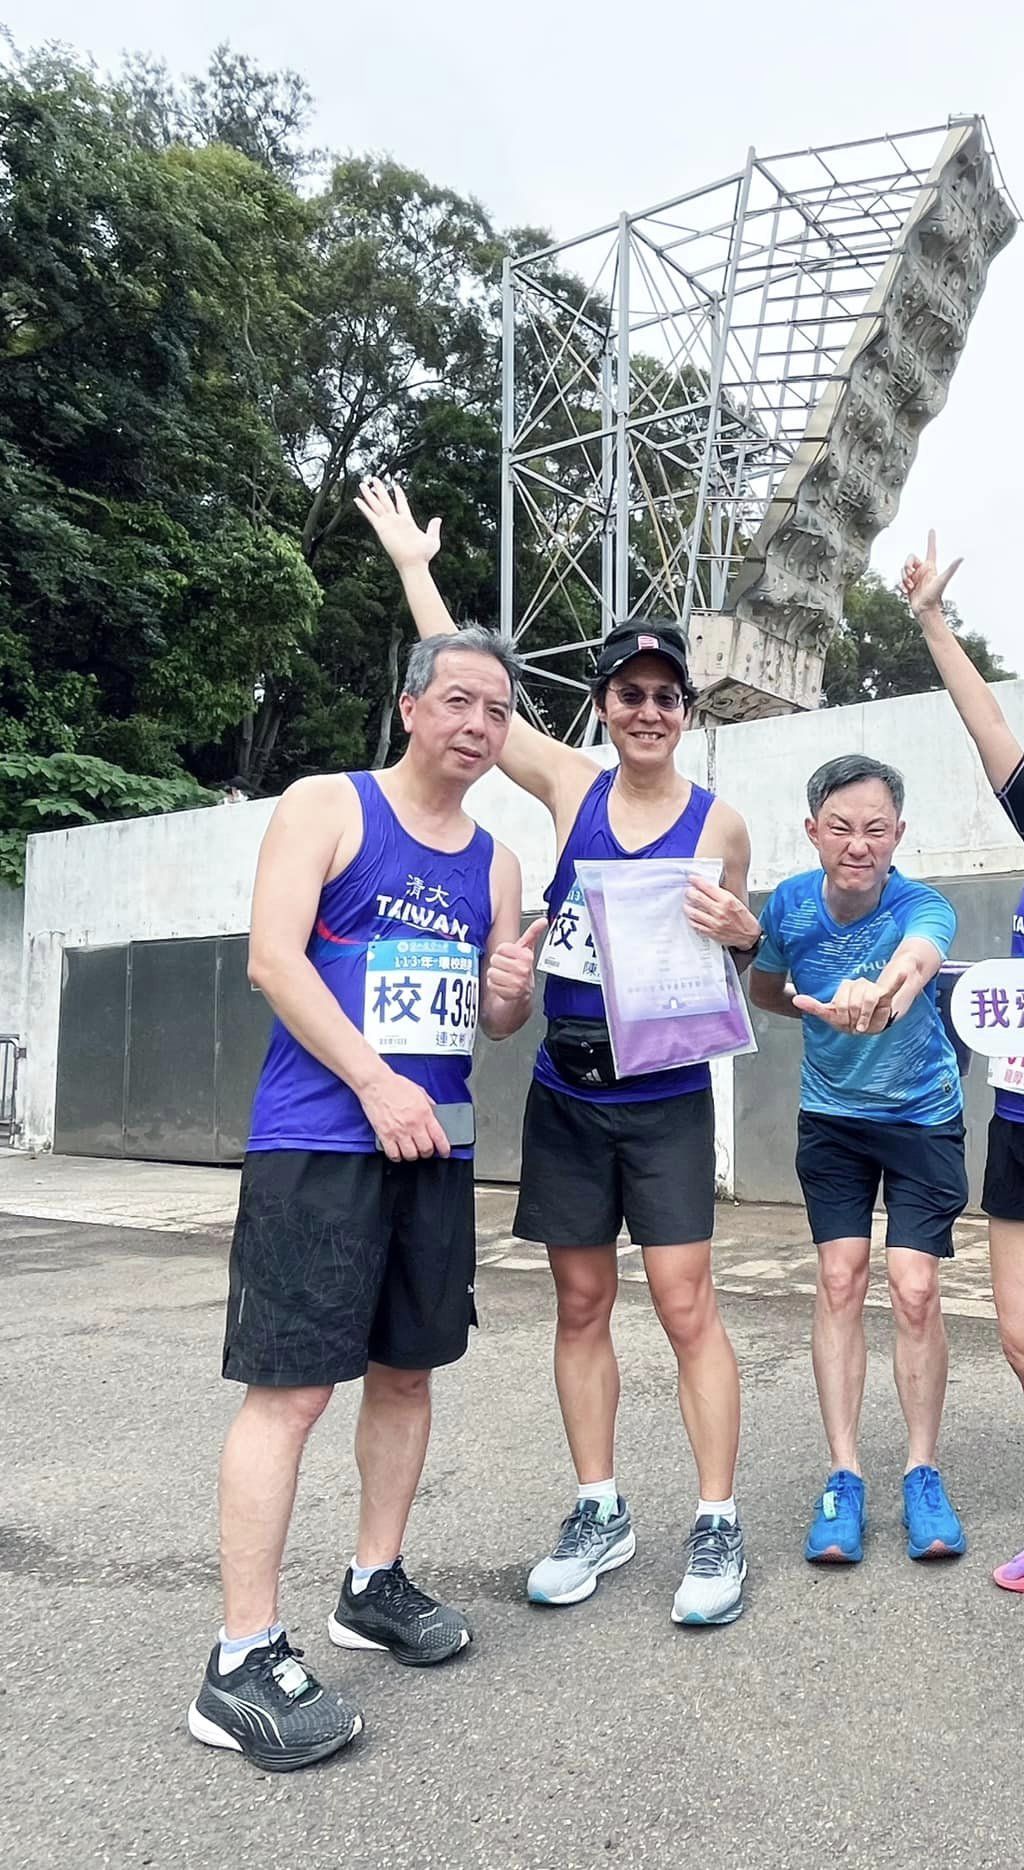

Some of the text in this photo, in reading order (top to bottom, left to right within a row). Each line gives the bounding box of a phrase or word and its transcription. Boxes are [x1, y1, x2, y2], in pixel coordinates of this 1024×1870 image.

[406, 873, 449, 908] 清大
[376, 894, 469, 942] TAIWAN
[372, 976, 422, 1023] 校
